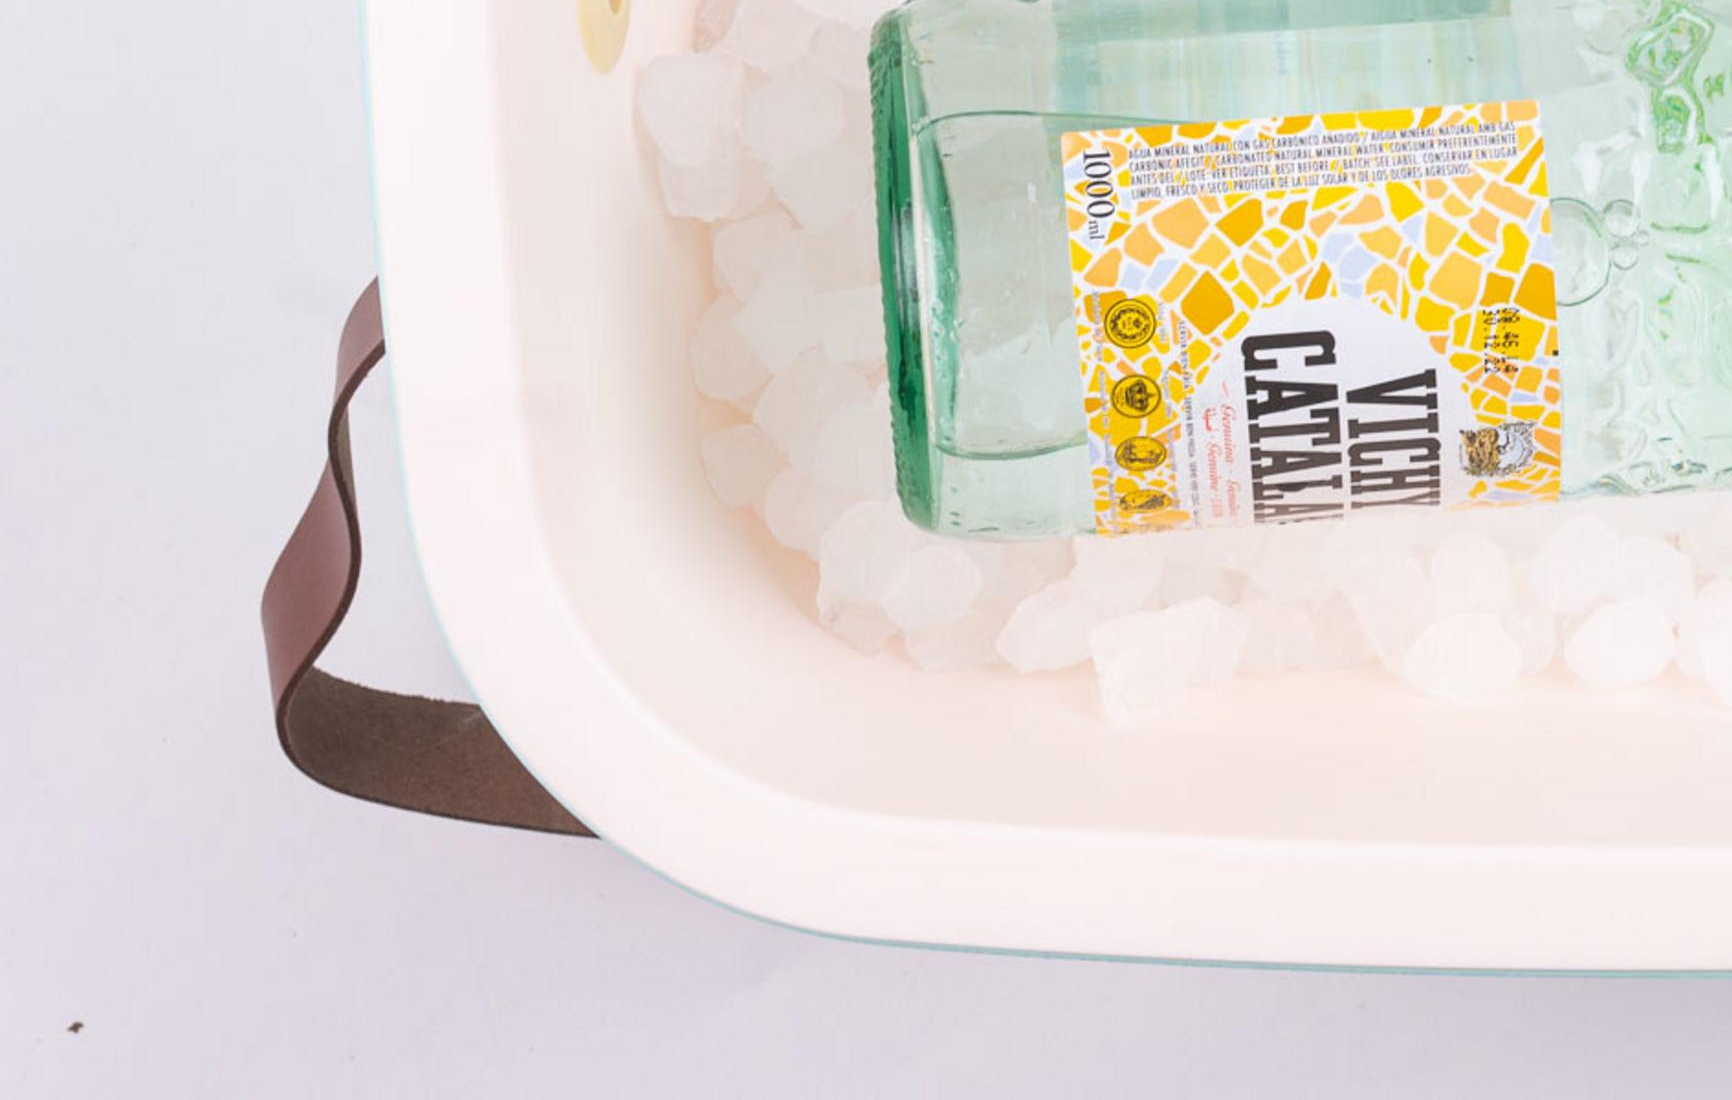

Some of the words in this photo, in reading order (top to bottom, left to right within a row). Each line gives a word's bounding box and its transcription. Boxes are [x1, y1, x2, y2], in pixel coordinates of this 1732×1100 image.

[1129, 148, 1151, 159] AGUA
[1154, 145, 1189, 156] MINERAL
[1193, 143, 1228, 154] NATURAL
[1234, 140, 1249, 150] CON
[1252, 139, 1270, 149] GAS
[1371, 131, 1397, 141] AIGUA
[1399, 128, 1434, 138] MINERAL
[1438, 124, 1474, 135] NATURAL
[1478, 123, 1496, 132] AMB
[1499, 121, 1515, 131] GAS
[1216, 152, 1271, 165] CARBONATED
[1274, 149, 1311, 160] NATURAL
[1315, 147, 1352, 157] MINERAL
[1390, 140, 1434, 152] CONSUMIR
[1438, 134, 1516, 148] PREFERENTEMENTE
[1131, 173, 1156, 185] ANTES
[1159, 172, 1175, 184] DEL
[1212, 168, 1226, 178] VER
[1275, 164, 1295, 174] BEST
[1298, 161, 1328, 172] BEFORE
[1375, 157, 1389, 168] SEE
[1423, 150, 1472, 164] CONSERVAR
[1476, 149, 1486, 159] EN
[1490, 146, 1517, 158] LUGAR
[1166, 184, 1196, 196] FRESCO
[1233, 179, 1274, 190] PROTEGER
[1279, 177, 1288, 187] DE
[1292, 176, 1301, 186] LA
[1305, 174, 1319, 186] LUZ
[1322, 172, 1347, 184] SOLAR
[1359, 171, 1368, 182] DE
[1372, 170, 1388, 180] LOS
[1391, 166, 1423, 180] OLORES
[1241, 330, 1344, 524] CATALA
[1346, 366, 1442, 509] VICHY
